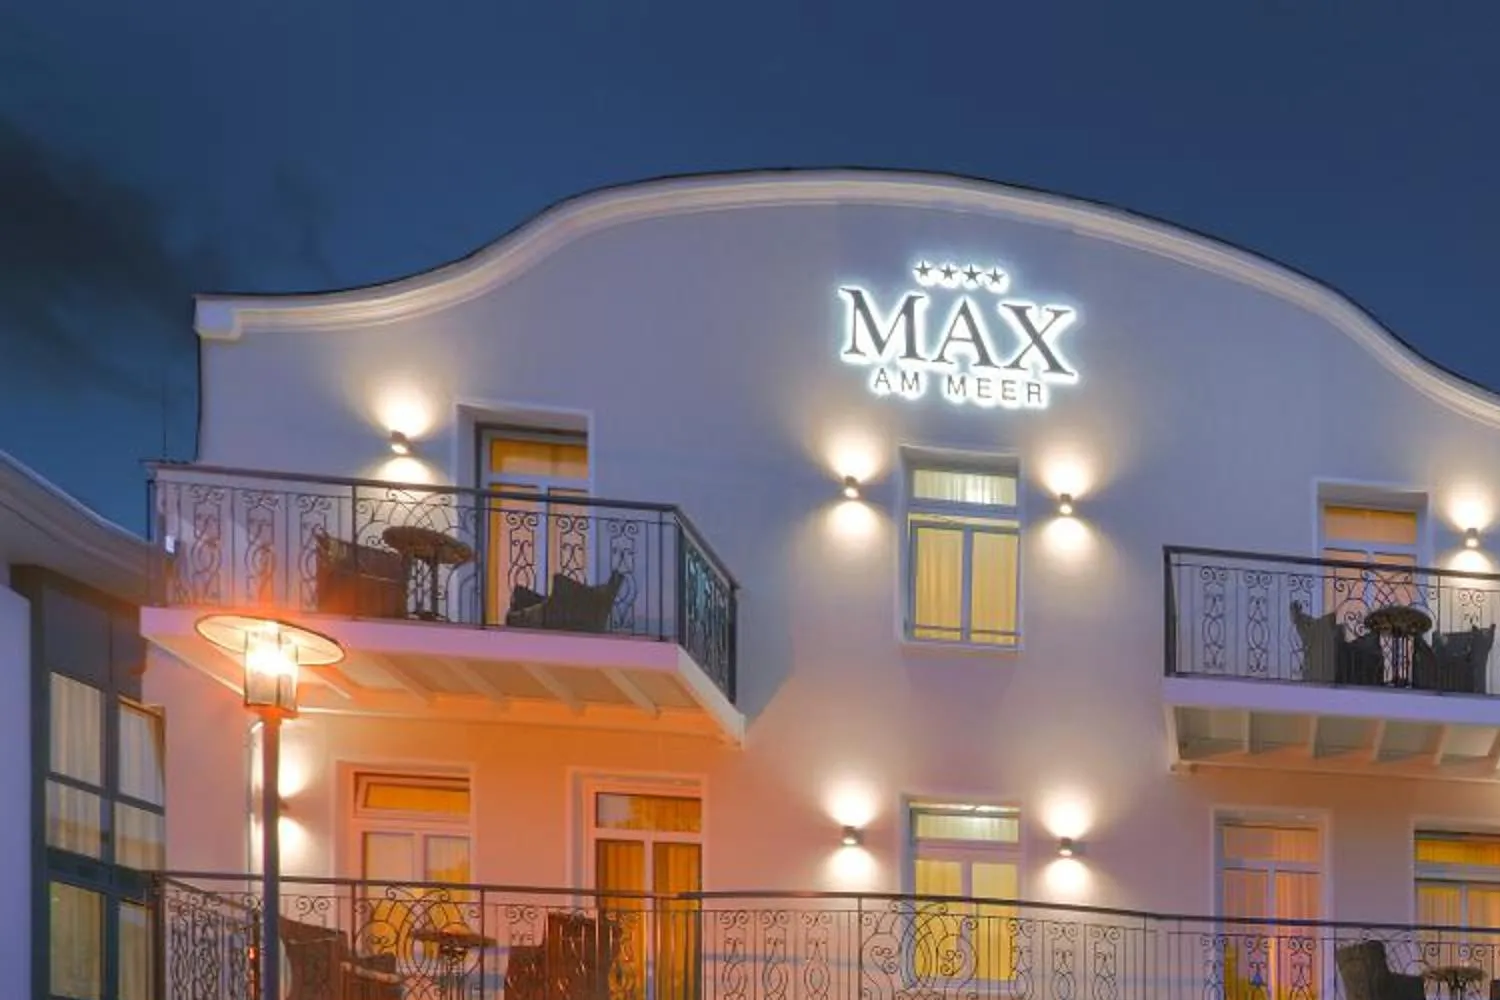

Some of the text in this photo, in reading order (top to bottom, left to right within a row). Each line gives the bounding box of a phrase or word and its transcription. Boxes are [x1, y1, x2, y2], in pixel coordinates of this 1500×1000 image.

[841, 286, 1075, 377] MAX
[874, 367, 1043, 404] AM MEER
